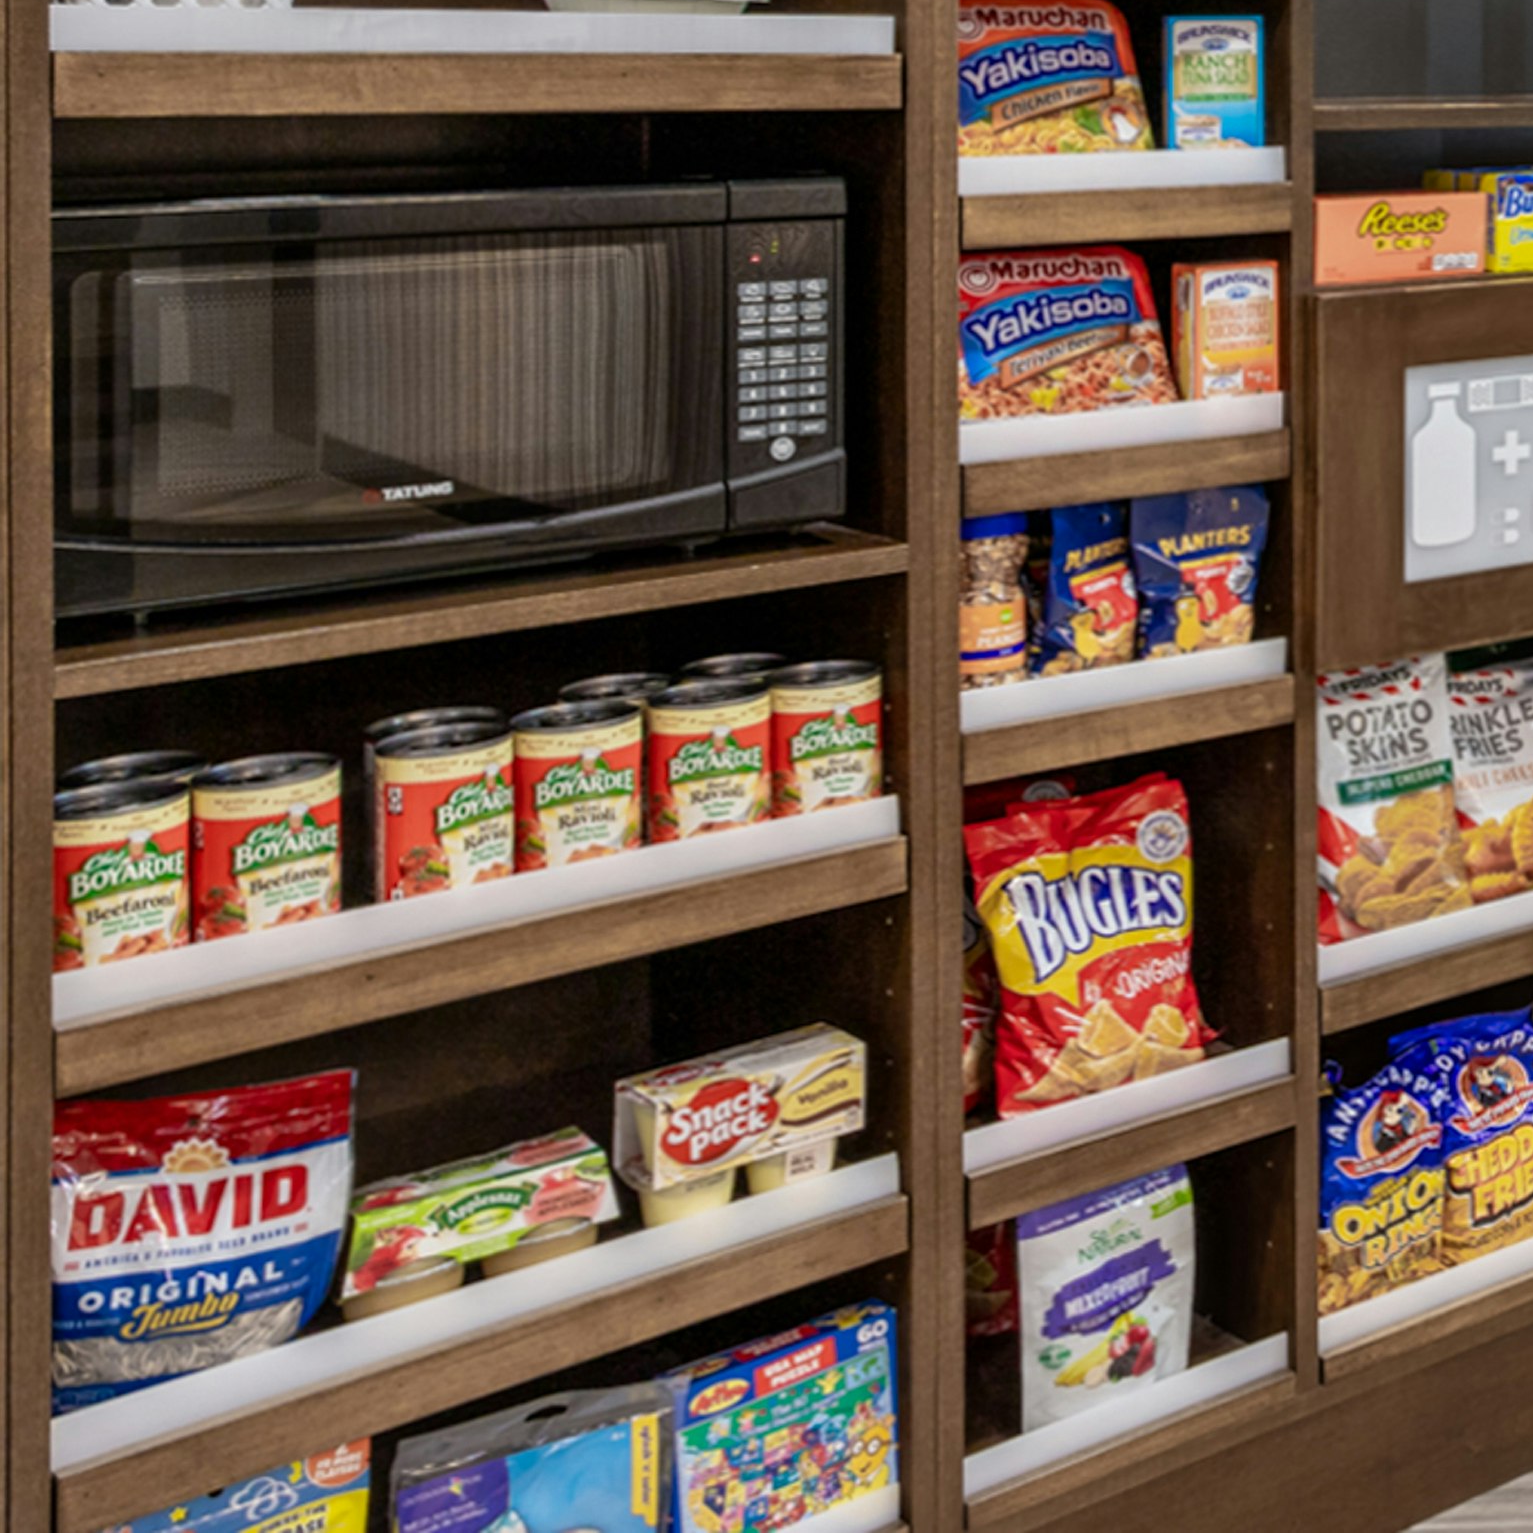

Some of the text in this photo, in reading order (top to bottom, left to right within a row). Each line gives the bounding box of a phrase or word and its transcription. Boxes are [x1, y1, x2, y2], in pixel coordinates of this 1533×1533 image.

[977, 8, 1107, 29] Maruchan
[961, 44, 1111, 95] Yakisoba
[1184, 53, 1248, 68] RANCH
[1000, 89, 1064, 120] Chicken
[1358, 201, 1450, 238] Reese's
[991, 258, 1123, 282] Maruchan
[1204, 273, 1270, 296] BRUNSWICK
[972, 292, 1128, 352] Yakisoba
[381, 481, 454, 501] TATUNG
[1157, 524, 1252, 557] PLANTERS
[1325, 699, 1434, 740] POTATO
[790, 723, 877, 756] BOYARDEE
[1346, 729, 1429, 766] SKINS
[1453, 729, 1525, 763] FRIES
[669, 746, 762, 781] BOYARDEE
[535, 769, 634, 804] BOYARDEE
[558, 808, 617, 830] Ravioli
[250, 868, 330, 896] Beefaroni
[85, 893, 176, 926] Beefaroni
[1003, 865, 1188, 985] BUGLES
[668, 1082, 770, 1145] Snack
[690, 1115, 768, 1162] pack
[67, 1164, 309, 1252] DAVID
[251, 1227, 289, 1243] BRAND
[78, 1262, 283, 1313] ORIGINAL
[120, 1292, 239, 1339] Jumbo
